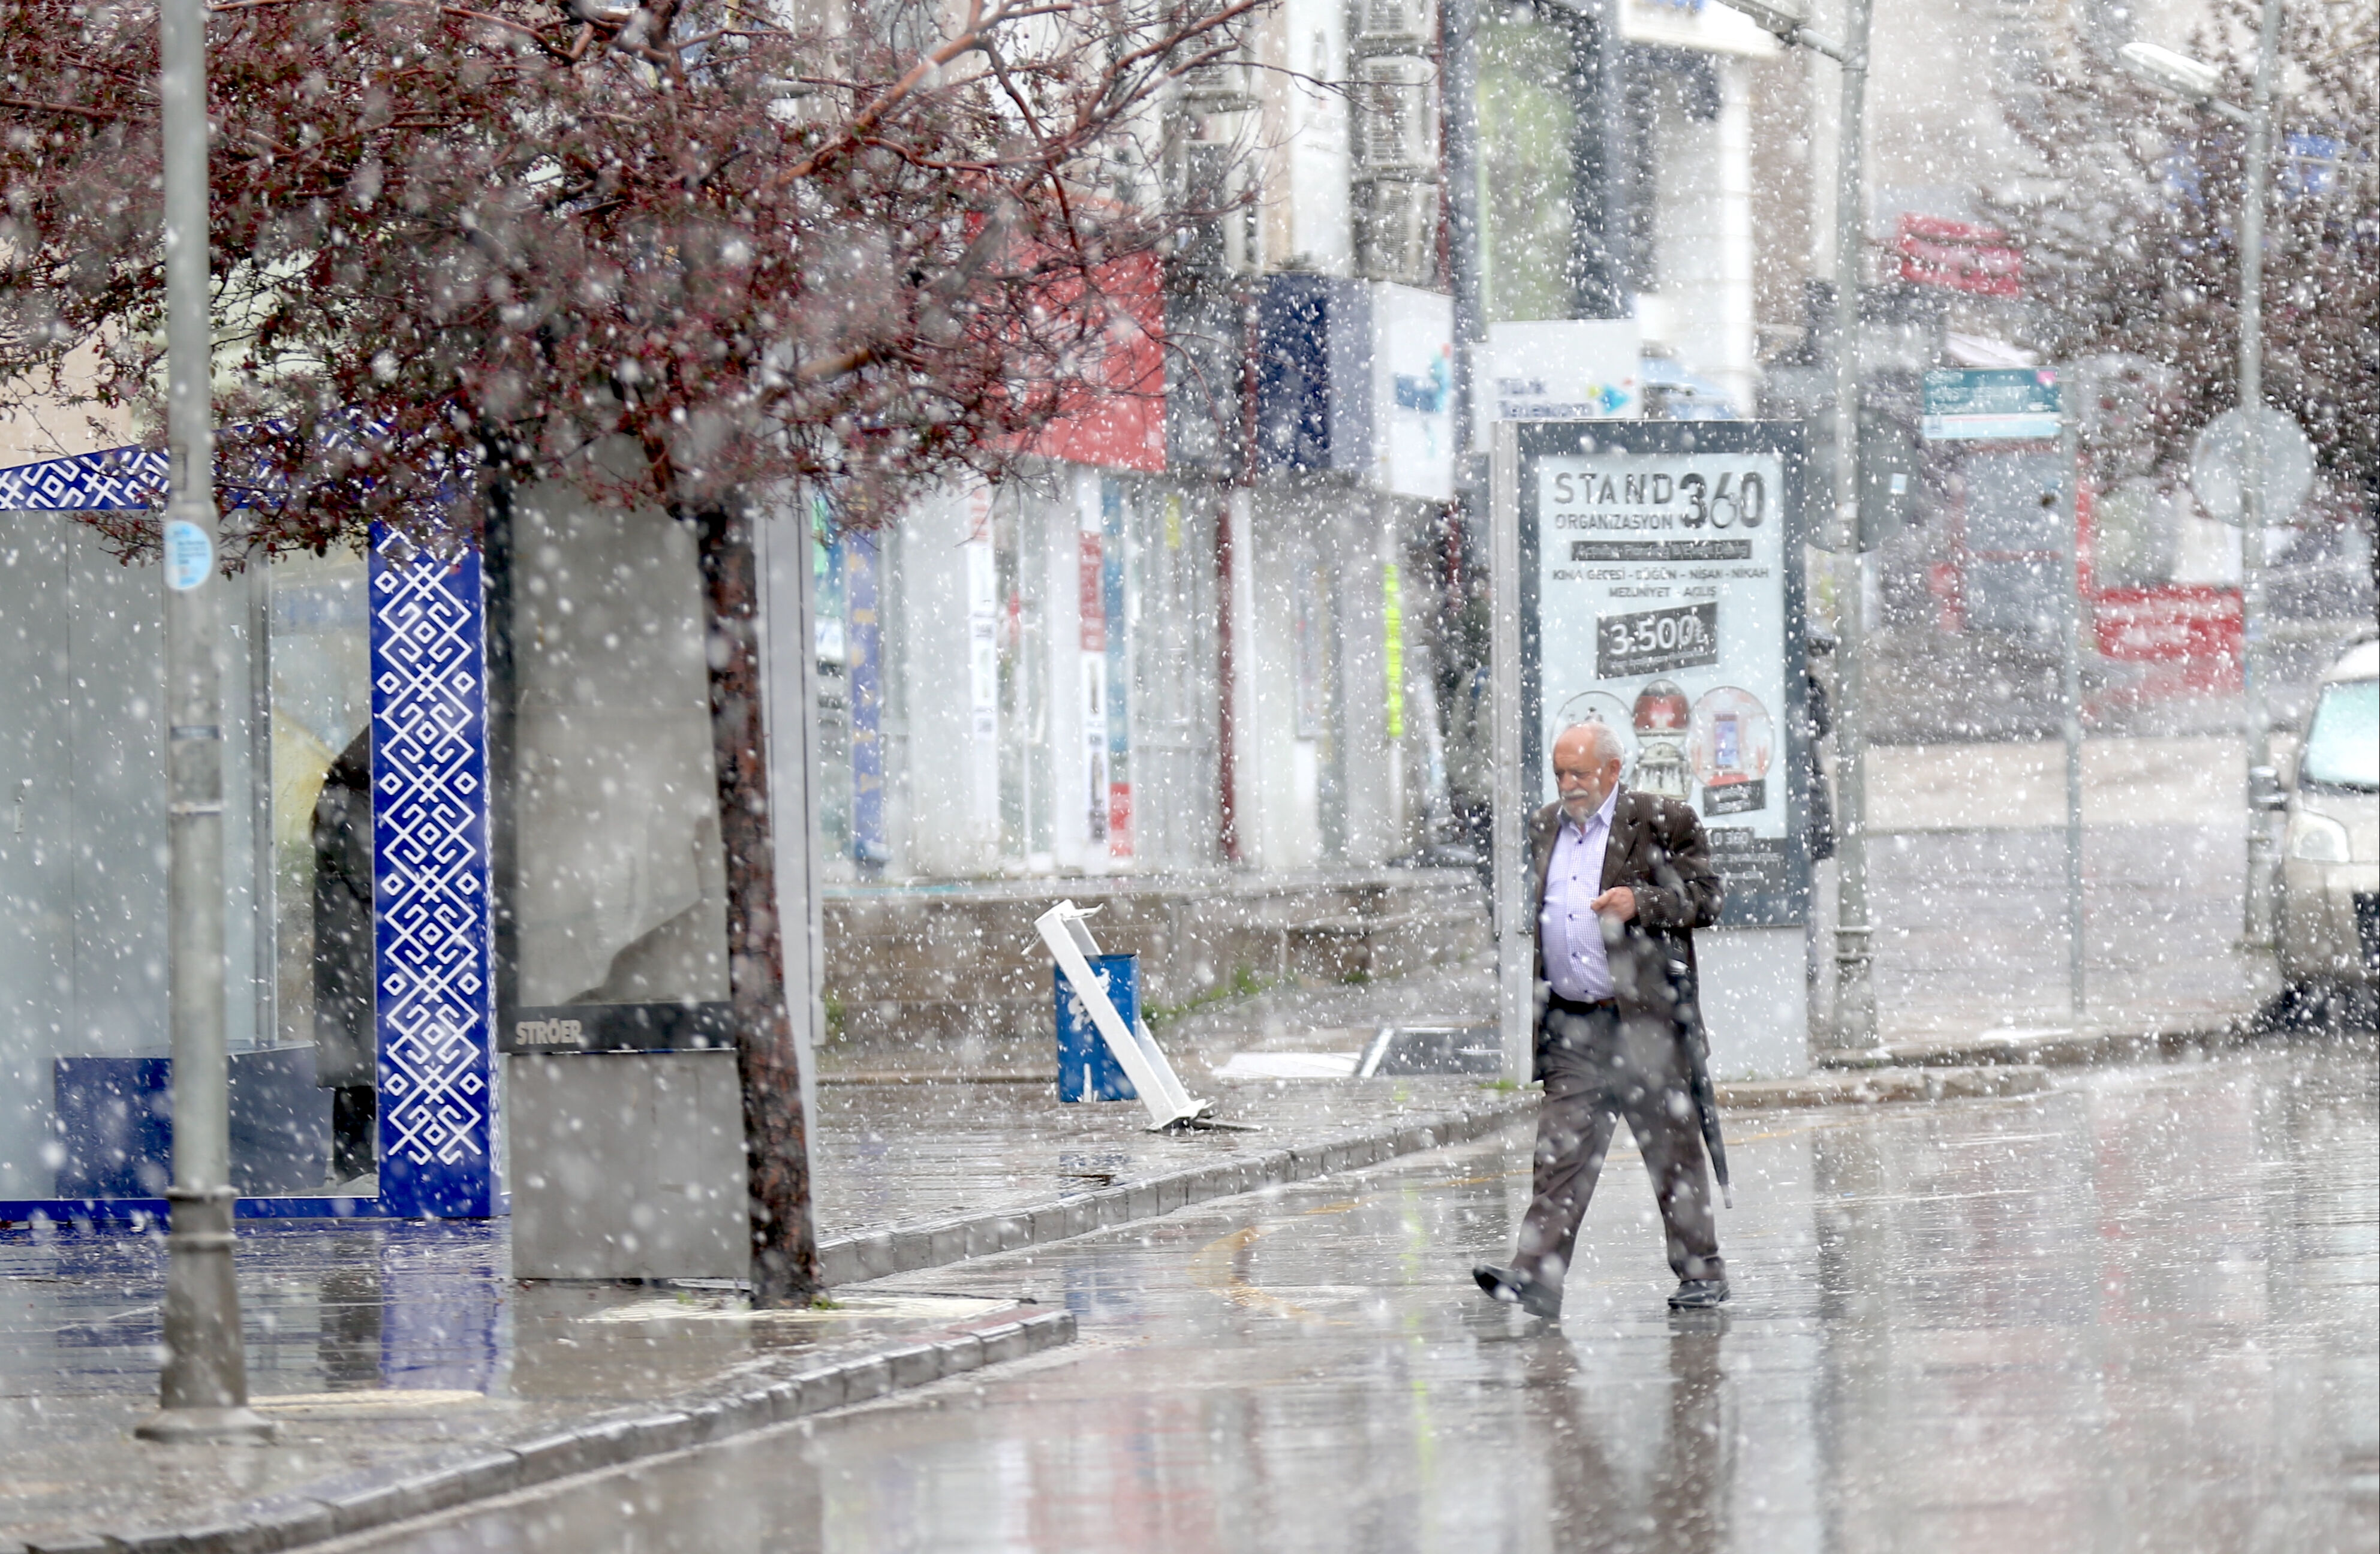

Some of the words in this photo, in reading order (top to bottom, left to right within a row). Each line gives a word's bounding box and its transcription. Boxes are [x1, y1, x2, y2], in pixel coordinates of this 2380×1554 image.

[1554, 471, 1675, 504] STAND
[1678, 471, 1767, 529] 360
[516, 1018, 582, 1045] STRÖER
